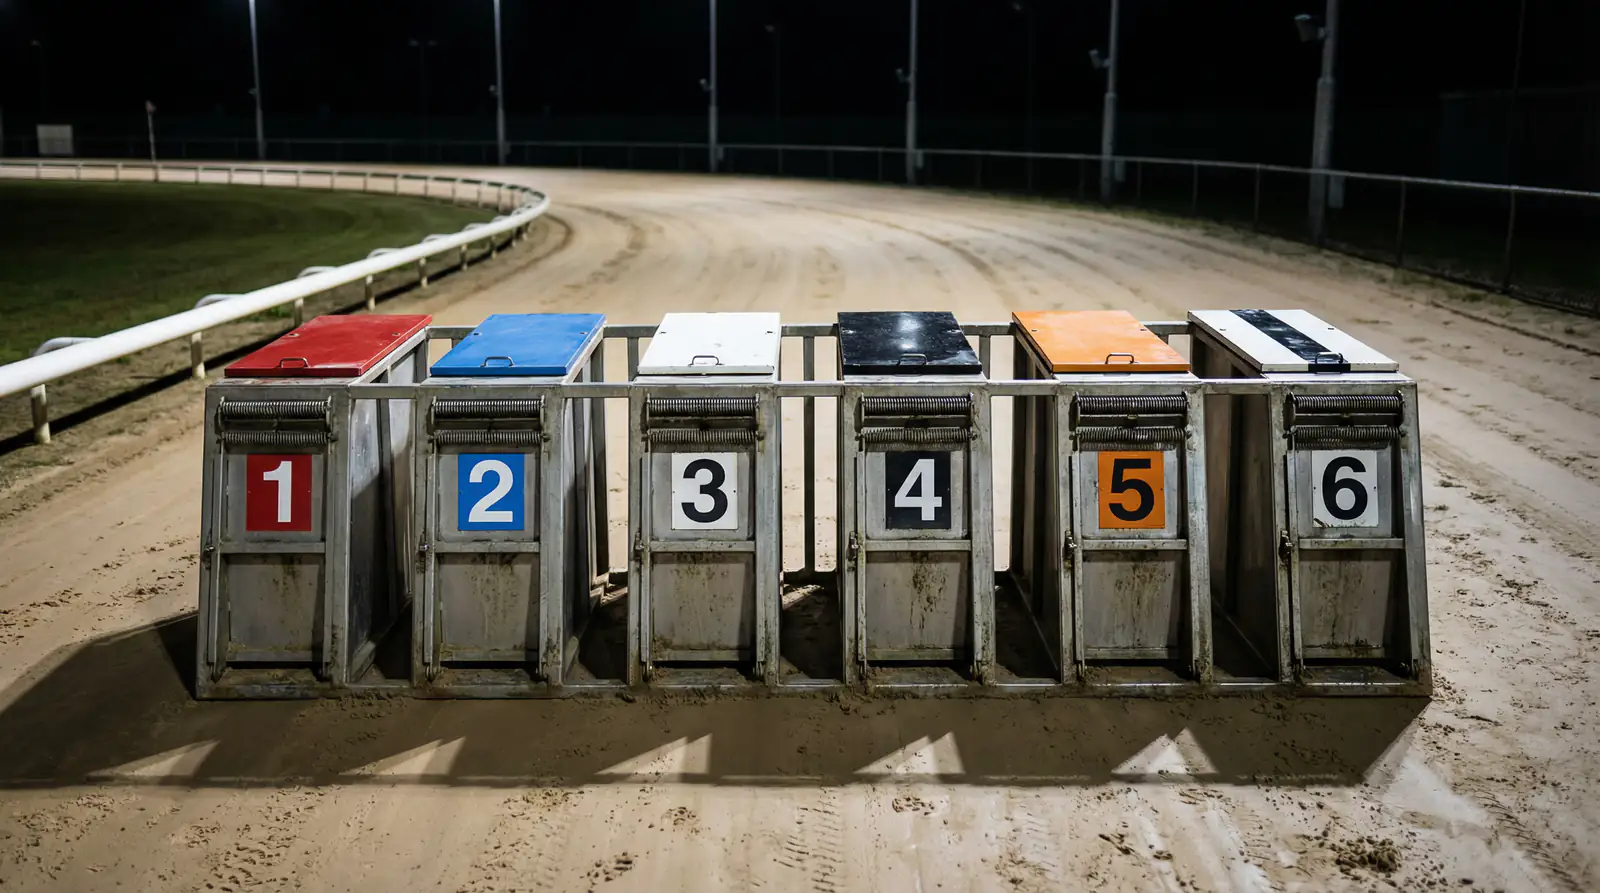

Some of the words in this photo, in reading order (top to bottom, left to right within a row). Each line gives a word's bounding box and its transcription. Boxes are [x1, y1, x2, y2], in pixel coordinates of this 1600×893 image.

[263, 460, 292, 522] 1
[468, 460, 514, 522] 2
[681, 459, 728, 522] 3
[895, 458, 942, 520] 4
[1109, 458, 1154, 521] 5
[1322, 456, 1368, 520] 6
